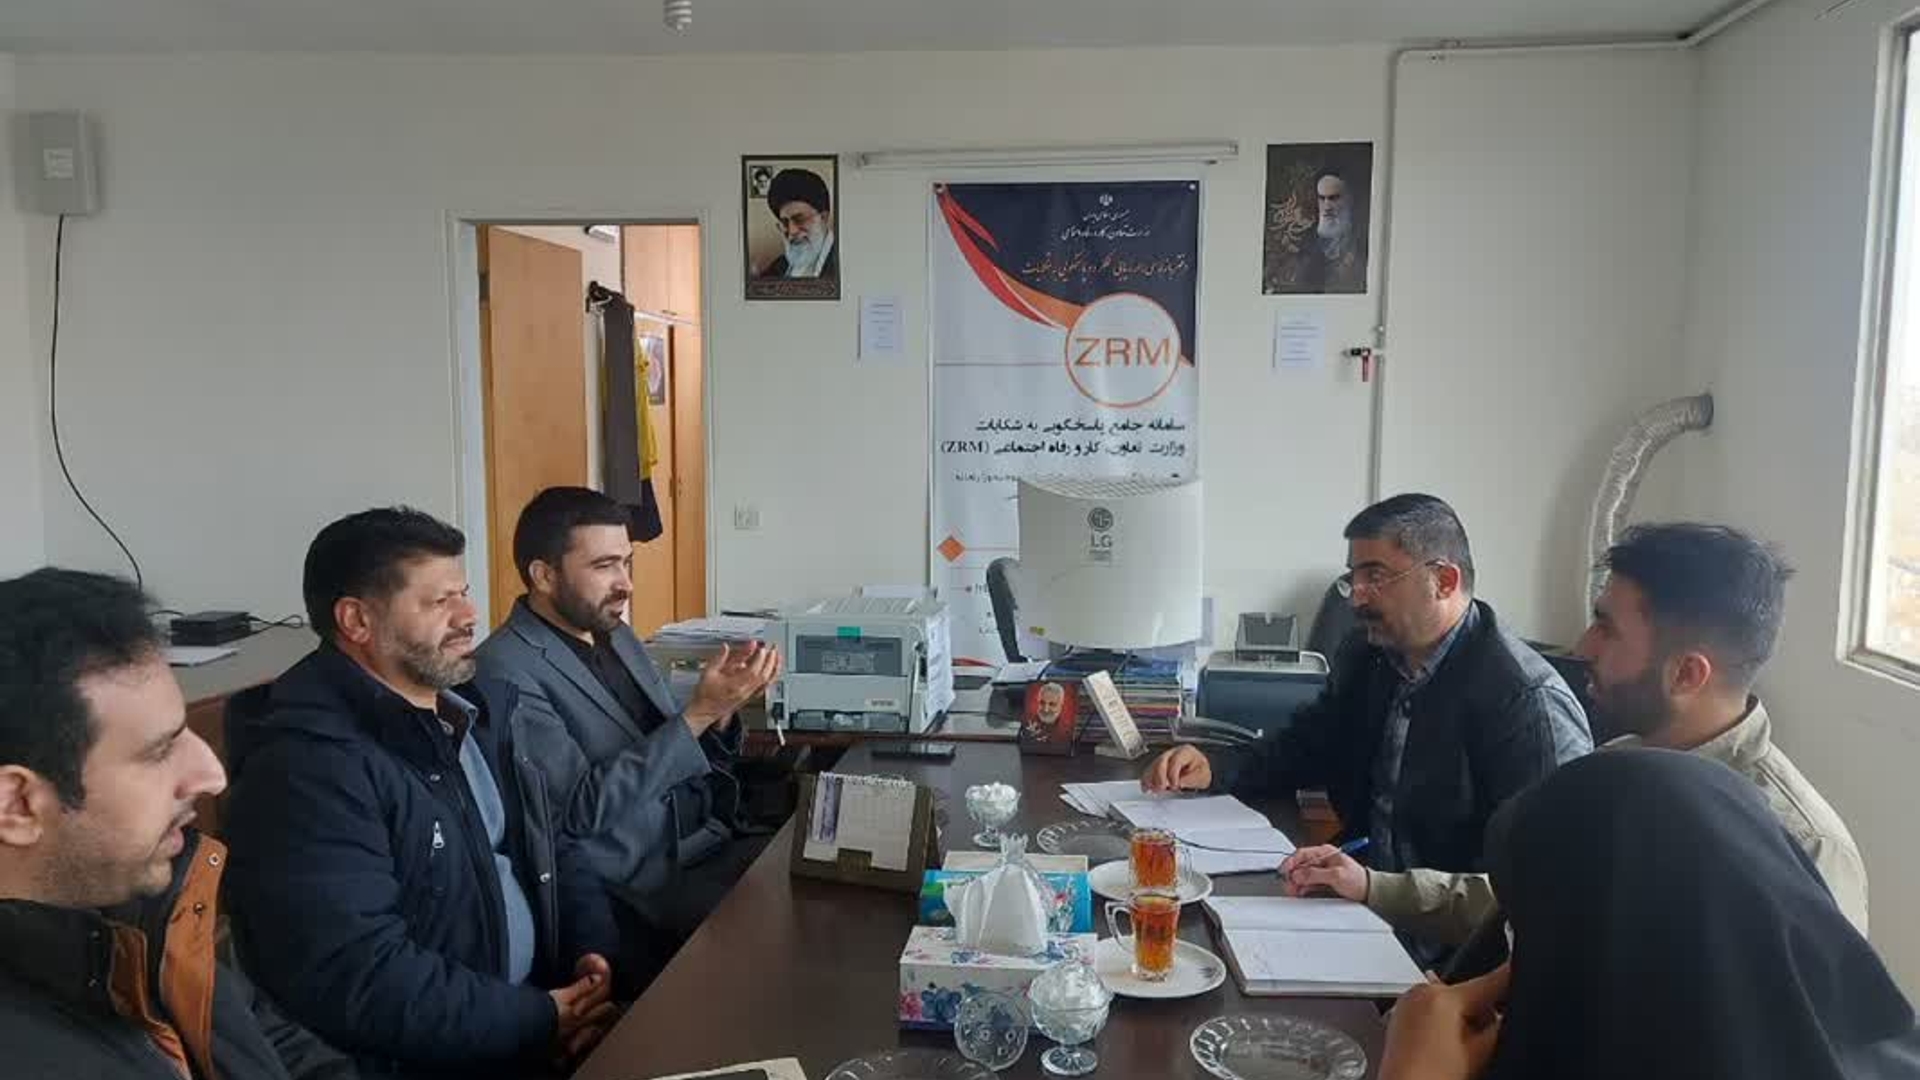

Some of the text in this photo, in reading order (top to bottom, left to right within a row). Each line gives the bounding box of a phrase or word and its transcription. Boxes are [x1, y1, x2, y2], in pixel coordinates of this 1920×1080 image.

[1075, 337, 1171, 366] ZRM
[976, 417, 1185, 436] سامانه جامع پاسخگویی به شکایات
[941, 440, 989, 454] (ZRM)
[994, 441, 1045, 457] اجتماعی
[1048, 441, 1072, 456] رفاه
[1073, 444, 1081, 456] و
[1082, 441, 1101, 456] کار
[1149, 441, 1185, 456] وزارت
[1091, 535, 1112, 547] LG
